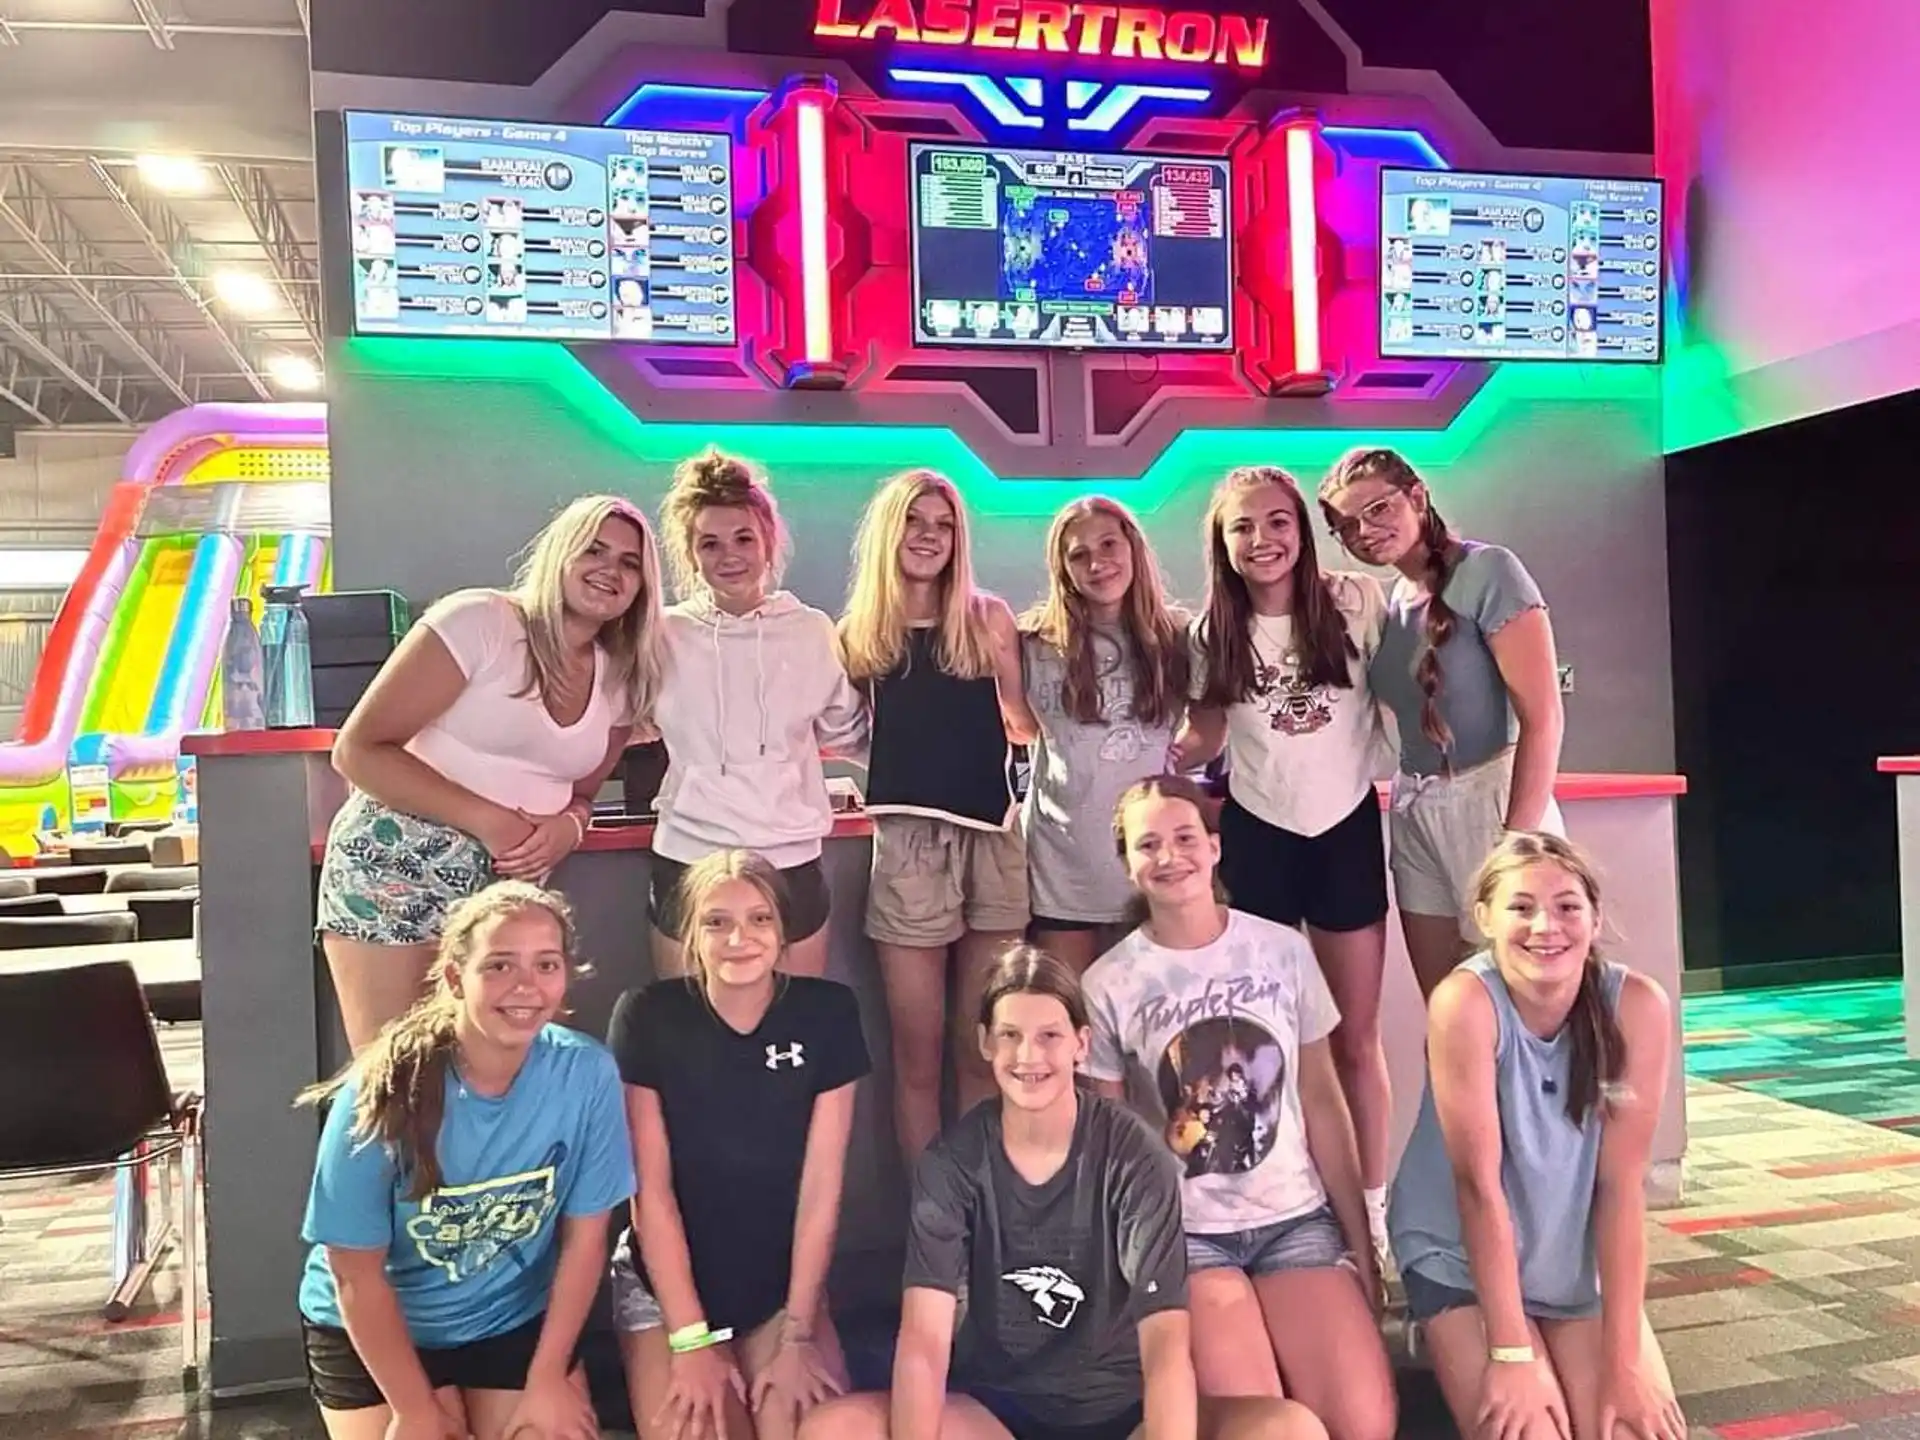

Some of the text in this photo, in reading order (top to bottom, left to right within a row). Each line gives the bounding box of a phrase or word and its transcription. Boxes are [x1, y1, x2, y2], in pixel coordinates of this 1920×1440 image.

[814, 0, 1270, 66] LASERTRON
[392, 120, 421, 134] Top
[425, 122, 491, 139] Players
[502, 127, 551, 142] Game
[1133, 975, 1281, 1050] Purple Rain
